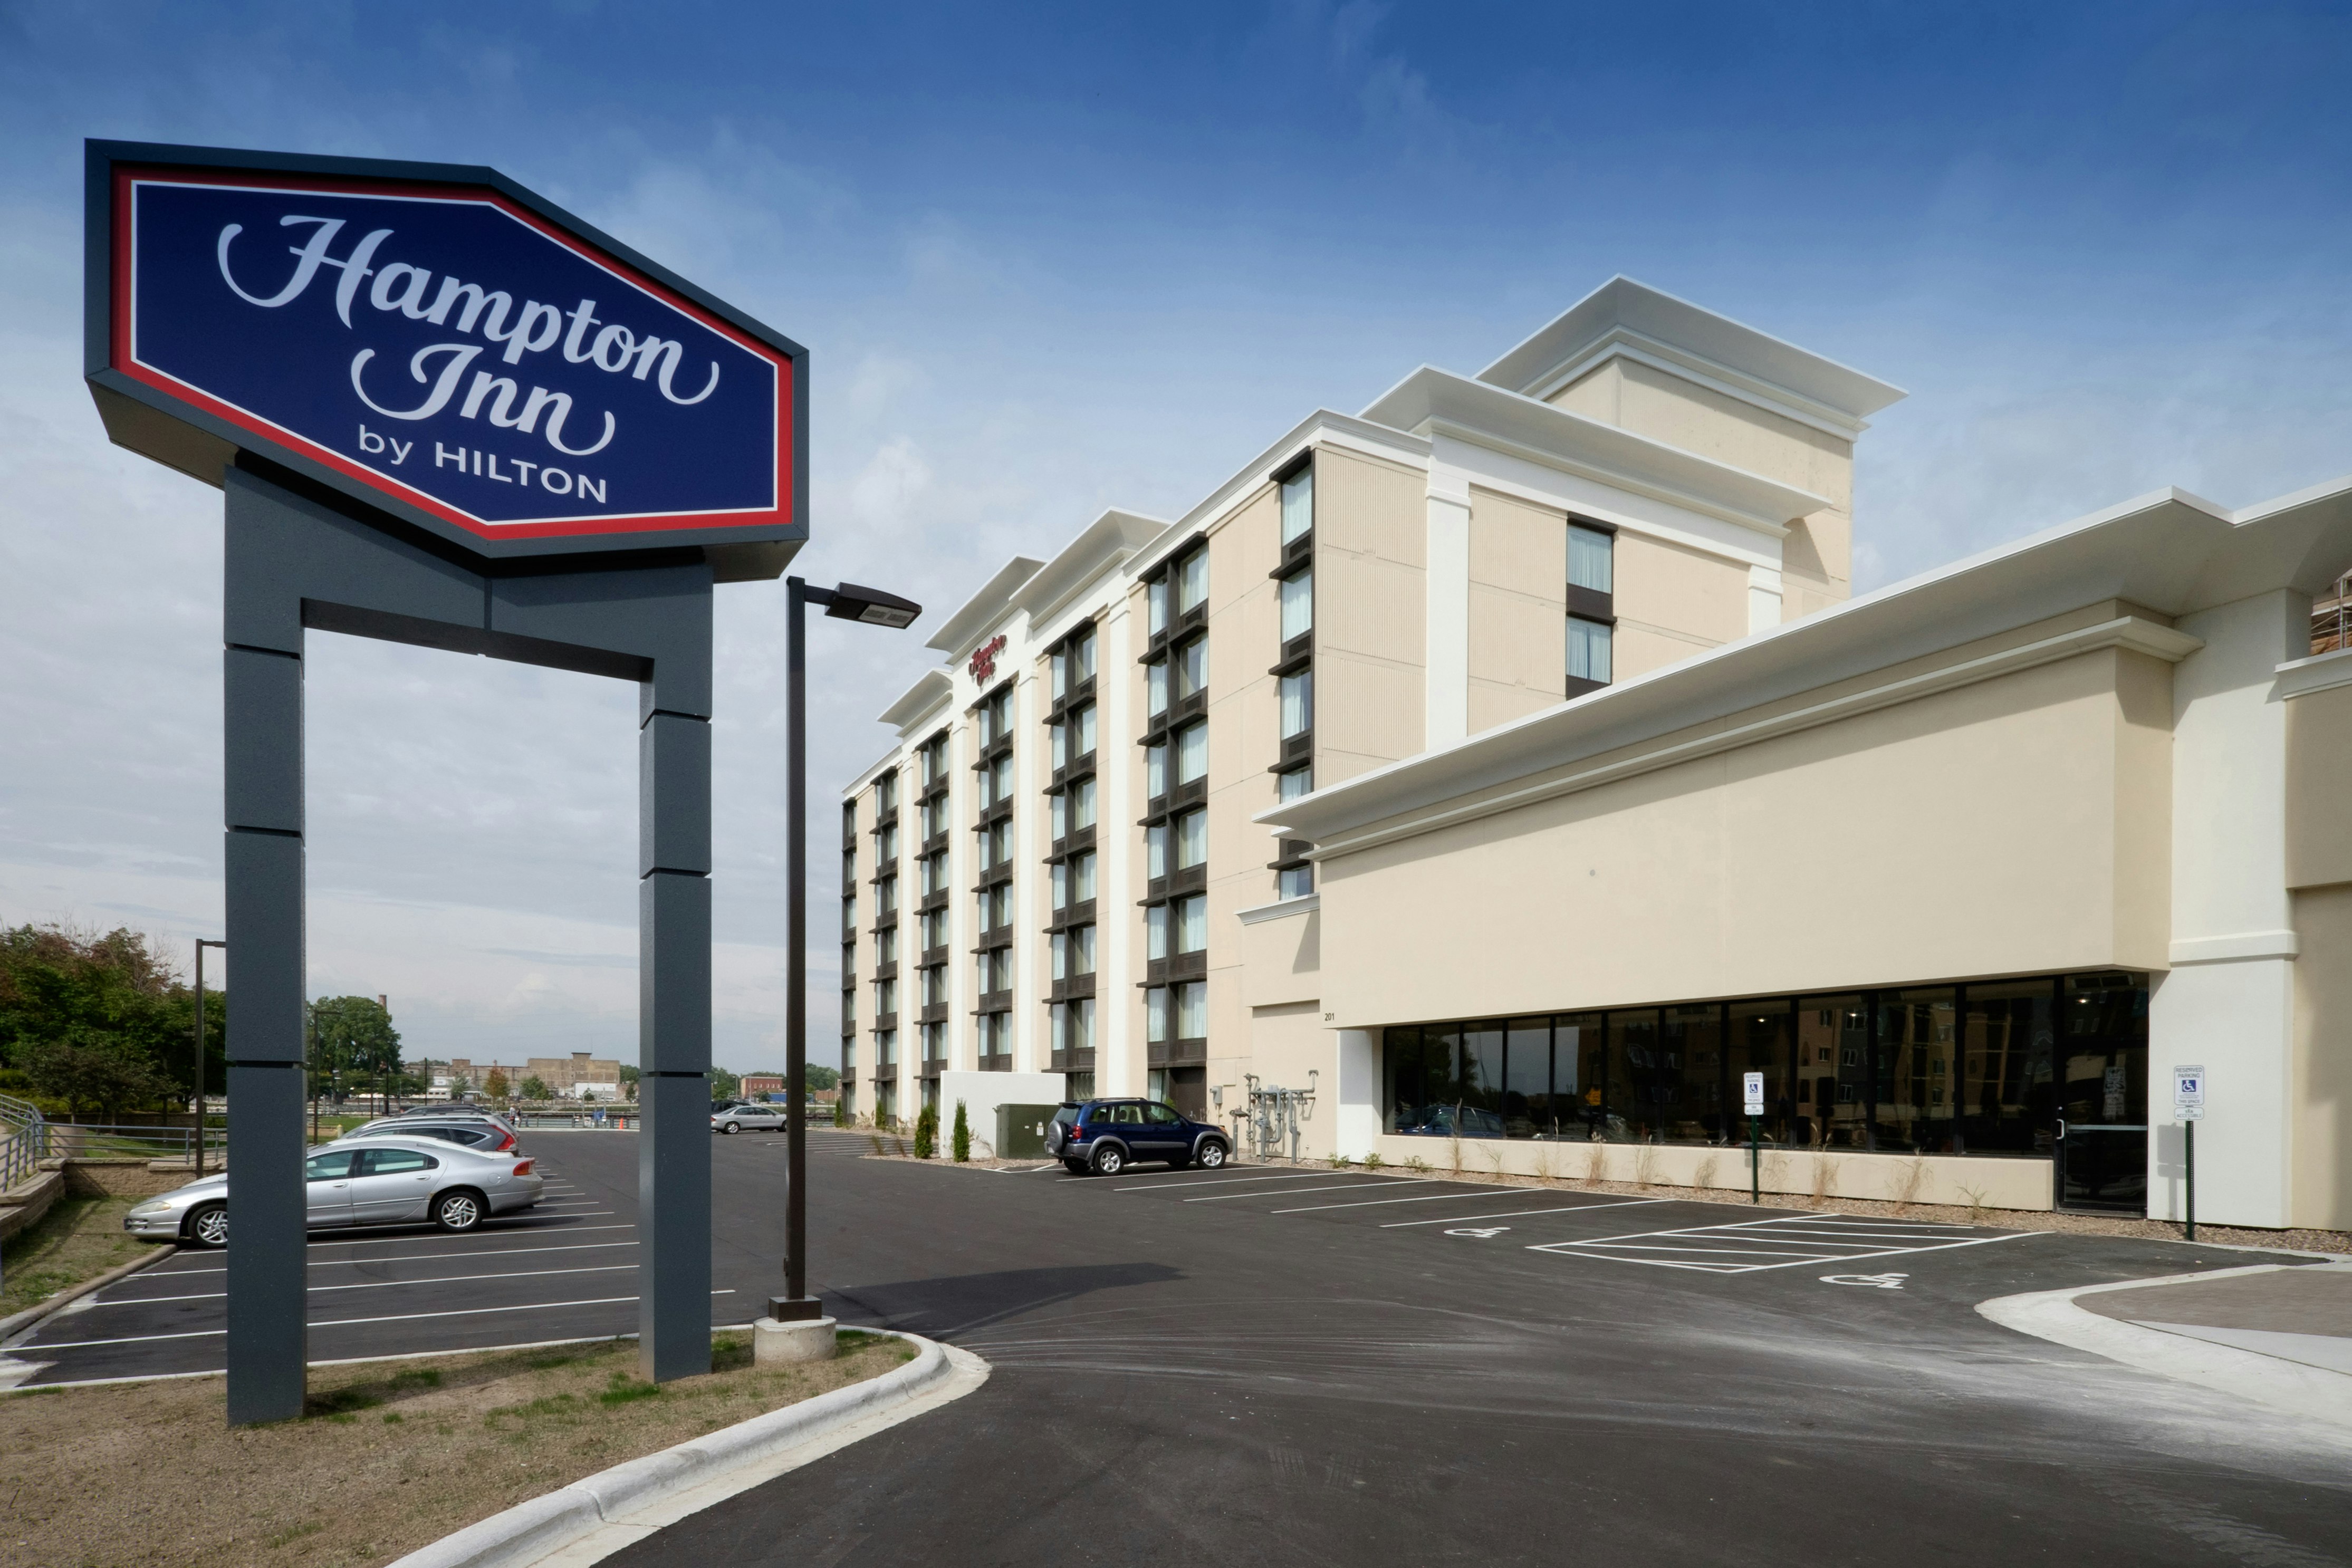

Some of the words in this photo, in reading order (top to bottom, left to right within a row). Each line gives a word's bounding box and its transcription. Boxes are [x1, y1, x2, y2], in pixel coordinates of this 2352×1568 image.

[217, 214, 719, 405] Hampton
[350, 343, 616, 456] Inn
[359, 424, 413, 465] by
[435, 441, 607, 504] HILTON
[1324, 1012, 1335, 1021] 201
